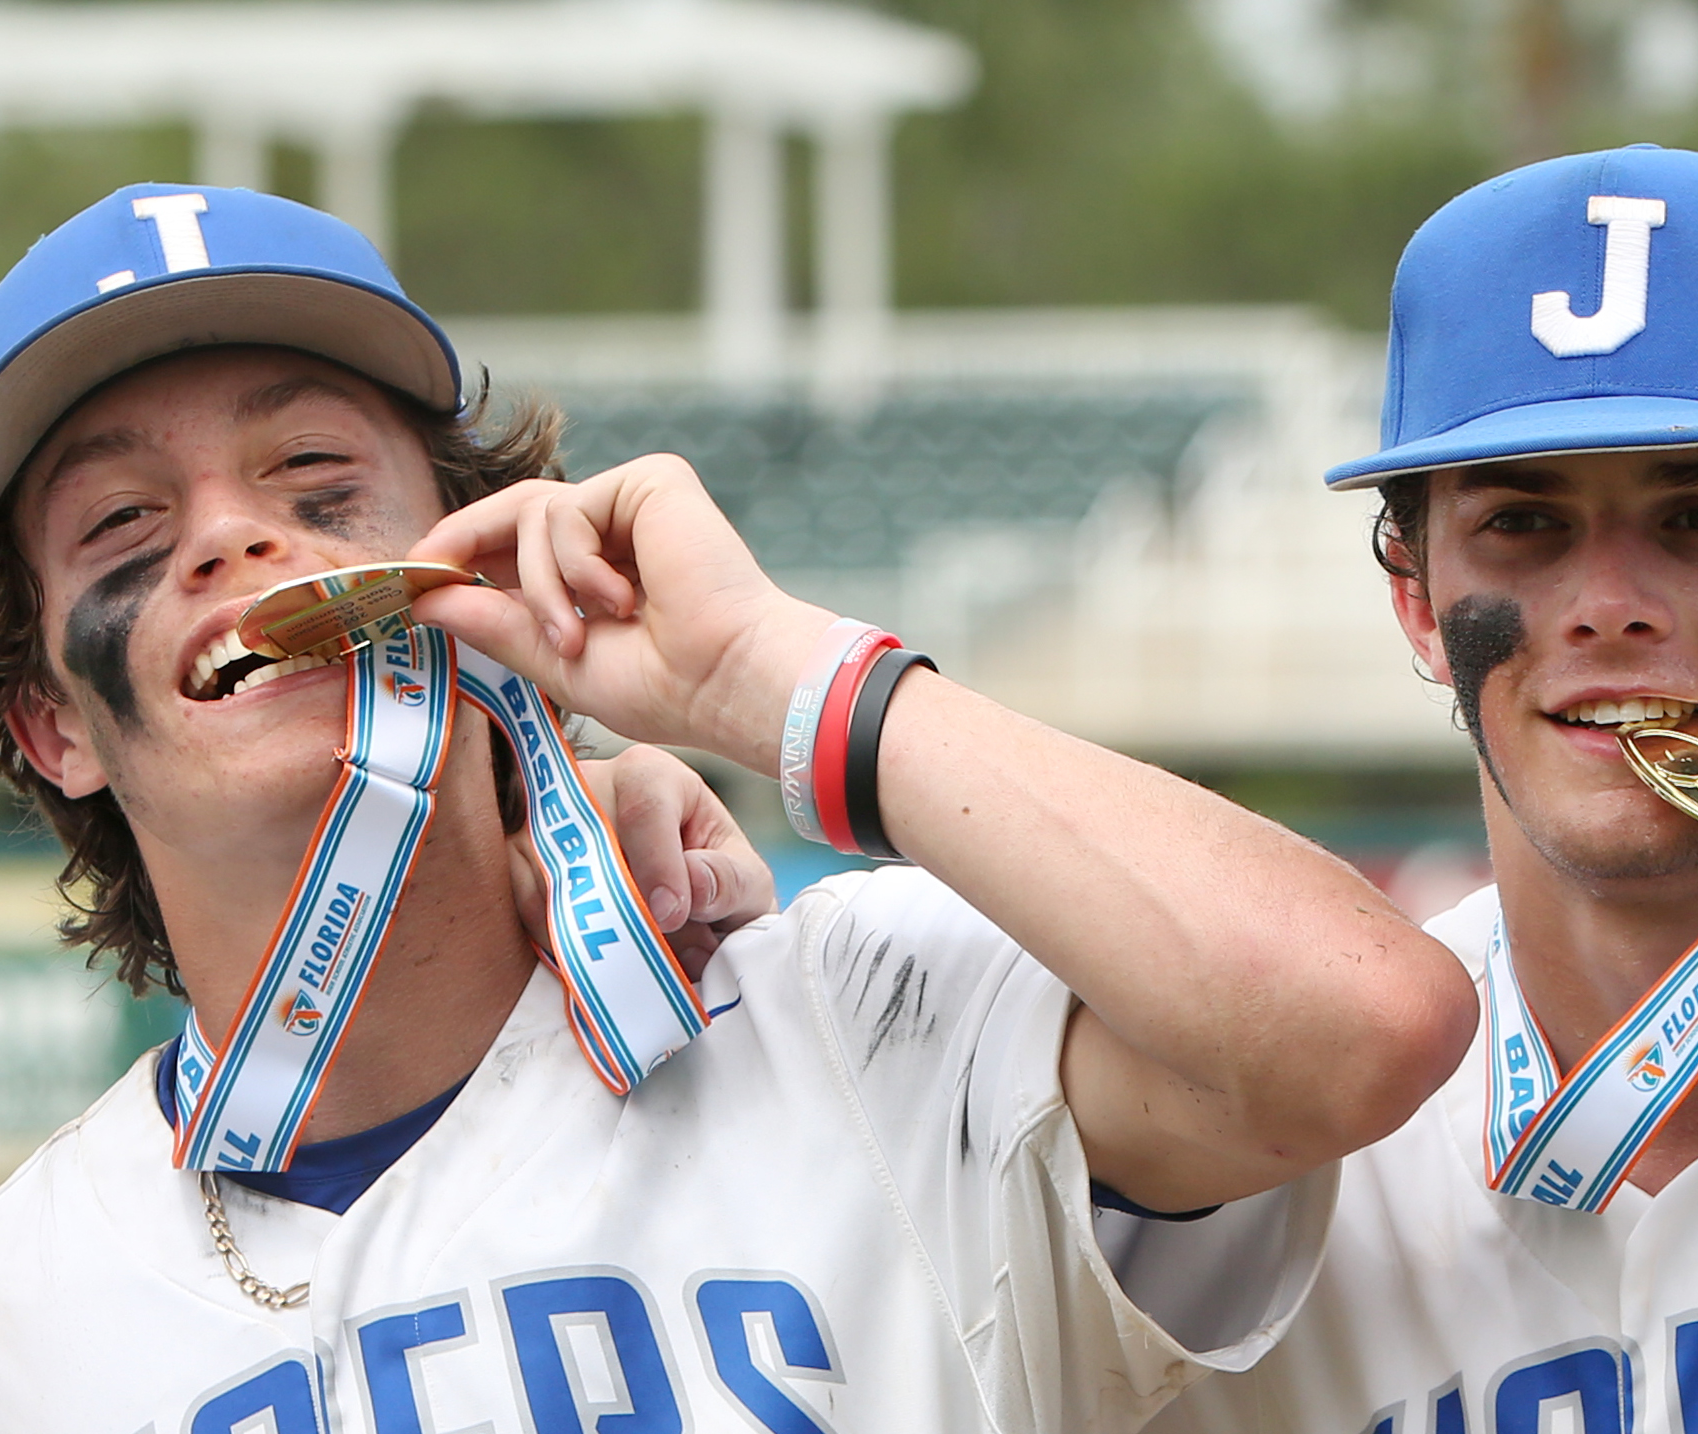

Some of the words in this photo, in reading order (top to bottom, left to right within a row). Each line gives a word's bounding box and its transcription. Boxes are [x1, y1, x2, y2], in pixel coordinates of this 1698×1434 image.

[1531, 196, 1667, 358] J
[286, 601, 354, 633] Champion
[357, 585, 392, 601] State
[500, 676, 620, 962] BASEBALL
[784, 687, 814, 832] ERMINUS
[298, 882, 360, 989] FLORIDA
